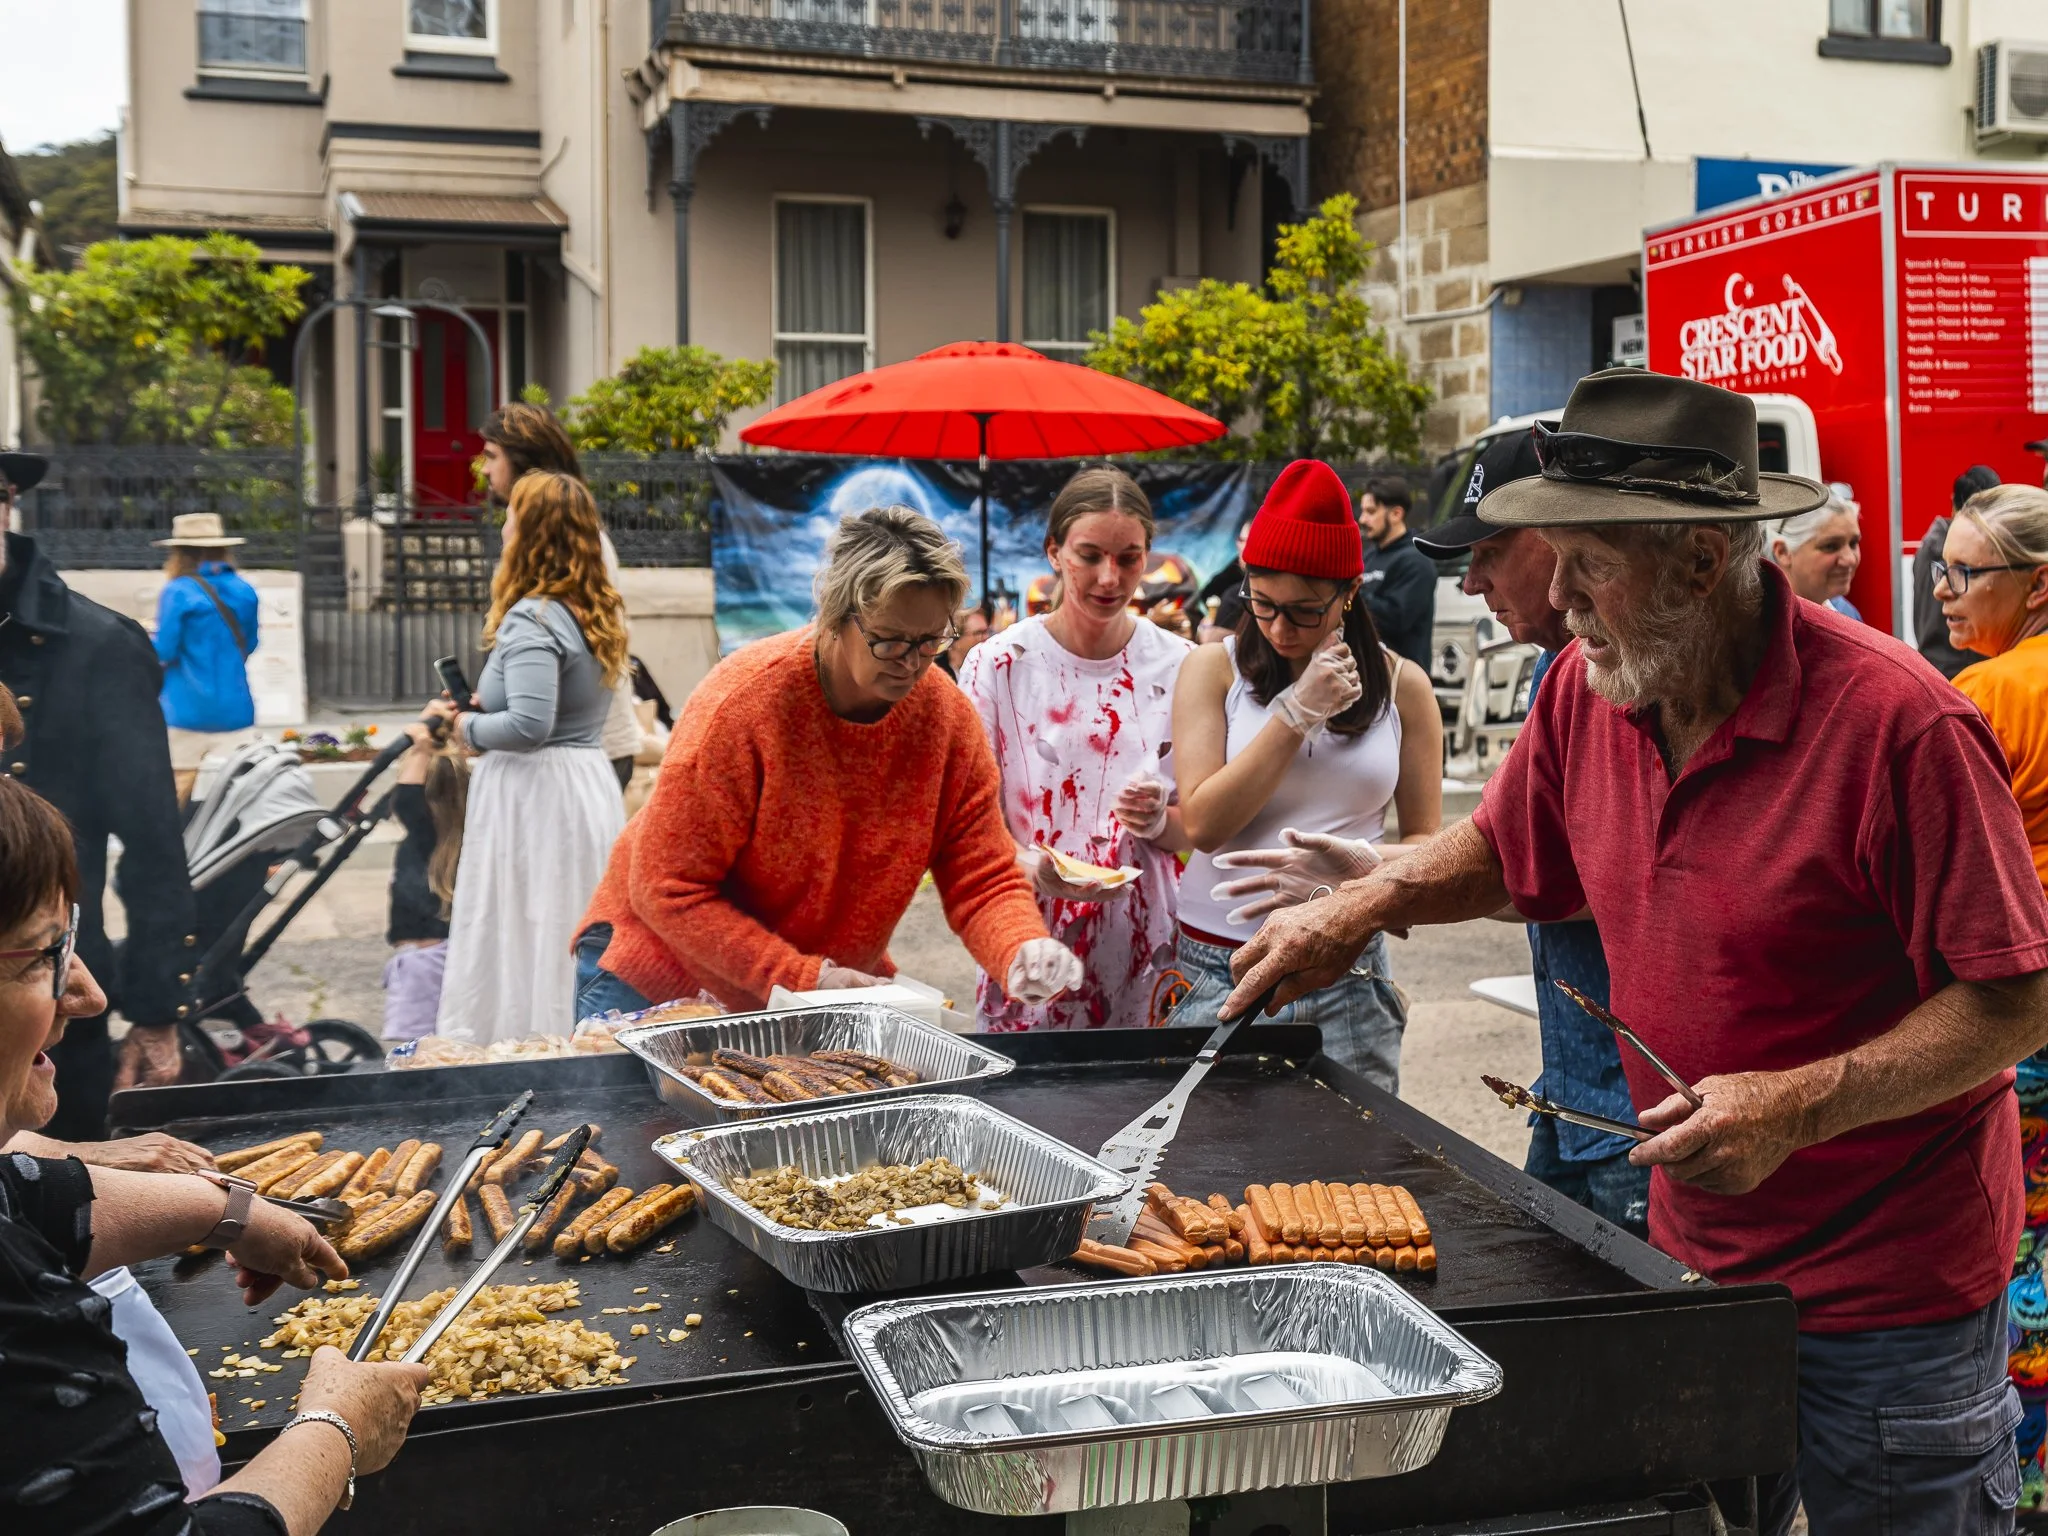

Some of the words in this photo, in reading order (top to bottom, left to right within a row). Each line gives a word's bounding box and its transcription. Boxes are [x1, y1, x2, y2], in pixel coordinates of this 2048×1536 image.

[1659, 222, 1745, 261] TURKISH
[1759, 190, 1865, 236] GOZLEME
[1915, 191, 2048, 223] TUR
[1680, 298, 1804, 352] CRESCENT
[1680, 344, 1738, 381] STAR
[1740, 332, 1807, 374] FOOD
